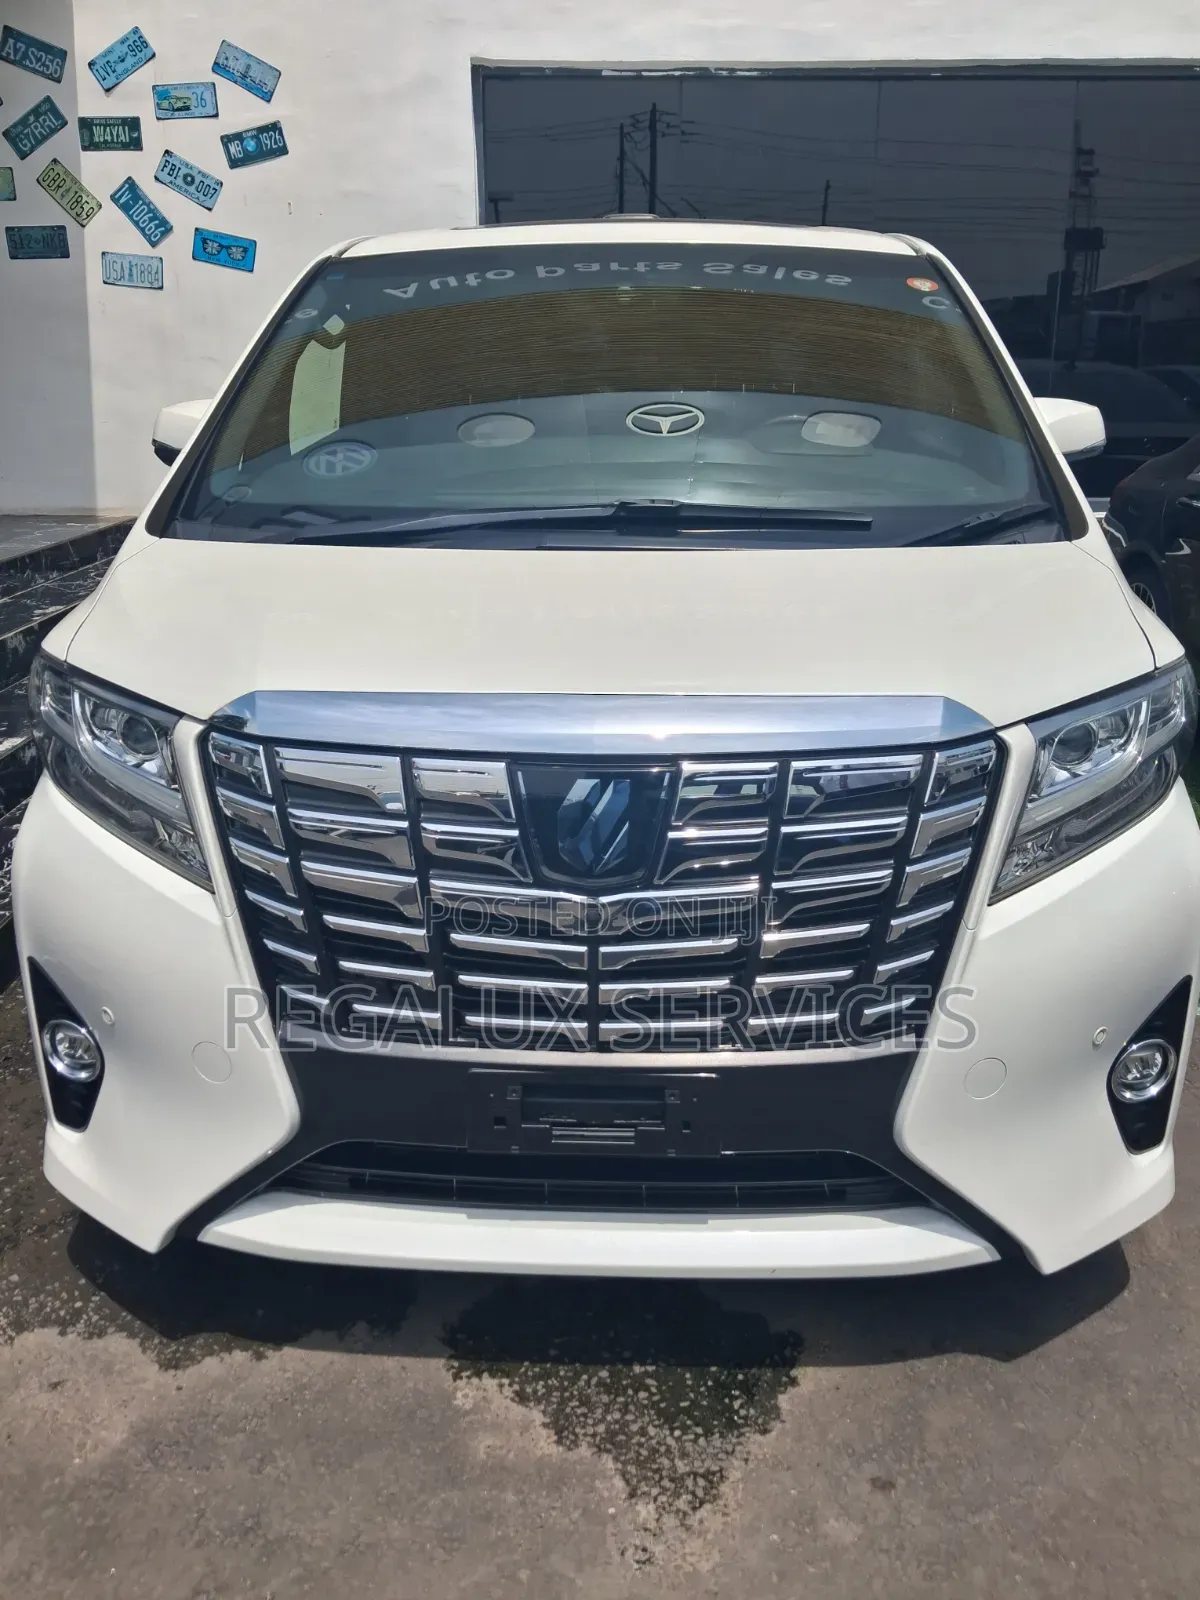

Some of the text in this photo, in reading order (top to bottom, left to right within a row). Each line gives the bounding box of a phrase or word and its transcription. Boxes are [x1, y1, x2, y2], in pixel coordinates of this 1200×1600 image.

[127, 36, 149, 57] 966
[259, 130, 284, 151] 1926
[161, 159, 218, 200] FBI 007
[66, 190, 95, 221] 1859
